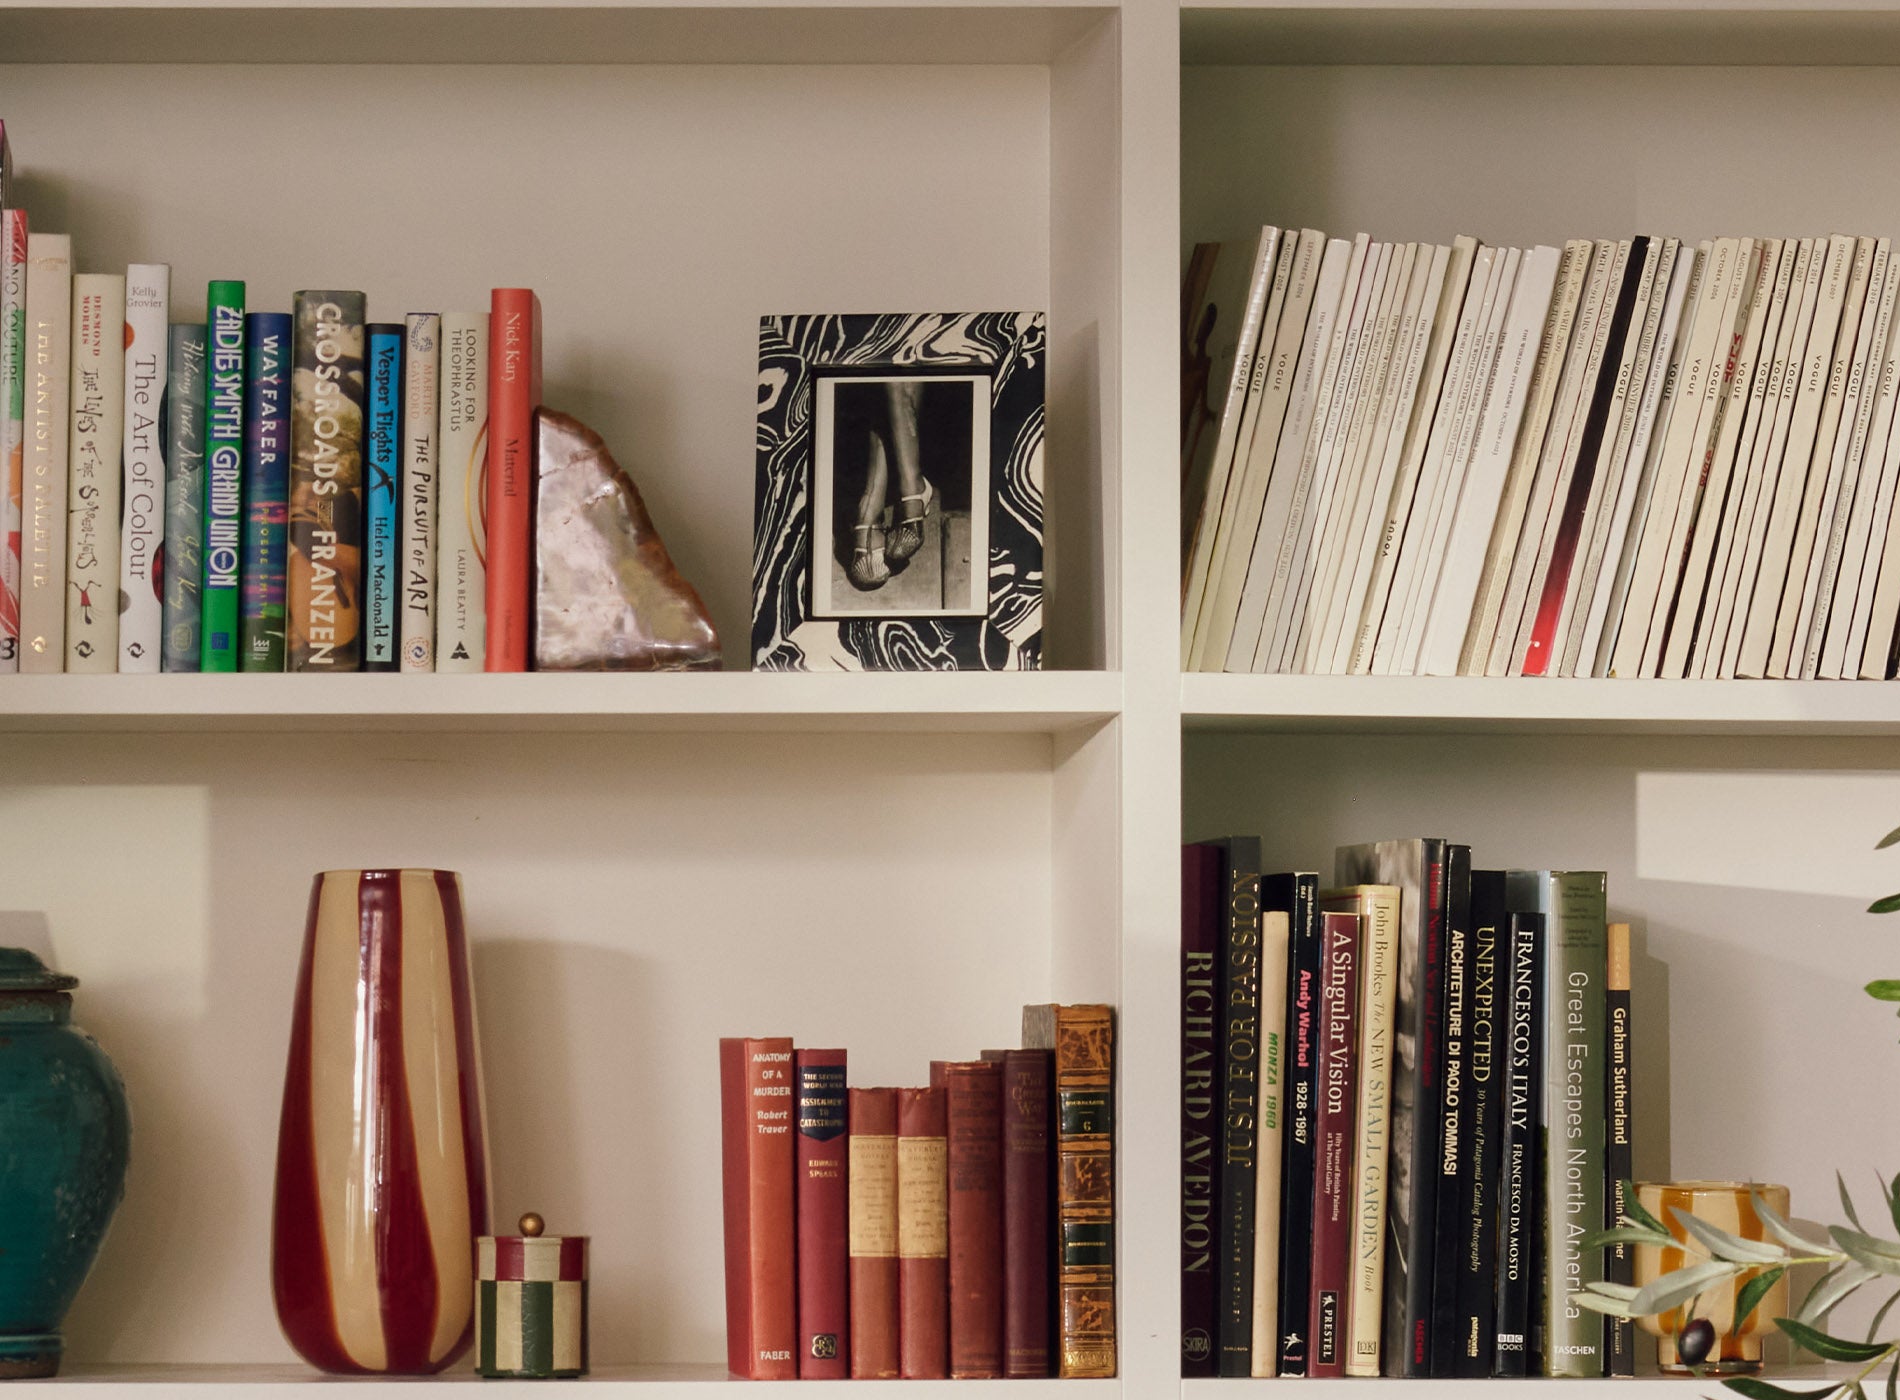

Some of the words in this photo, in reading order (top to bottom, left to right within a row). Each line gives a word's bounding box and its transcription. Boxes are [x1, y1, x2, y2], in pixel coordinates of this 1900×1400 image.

[1716, 248, 1727, 283] OCTOBER
[1834, 244, 1845, 283] DECEMBER
[1874, 250, 1886, 287] FEBRUARY
[127, 298, 162, 309] Grovier
[133, 286, 156, 298] Kelly
[2, 301, 20, 385] COUTURE
[81, 296, 90, 345] MORRIS
[92, 296, 101, 356] DESMOND
[215, 305, 241, 372] ZADIE
[504, 312, 520, 348] Nick
[37, 319, 55, 368] THE
[464, 329, 476, 394] LOOKING
[133, 355, 156, 404] The
[178, 340, 204, 396] Hiking
[376, 347, 395, 406] Vesper
[410, 360, 421, 419] GAYFORD
[423, 364, 433, 415] MARTIN
[450, 328, 462, 432] THEOPHRASTUS
[501, 351, 519, 383] Kary
[1236, 353, 1250, 392] VOGUE
[1252, 355, 1266, 393] VOGUE
[1274, 353, 1288, 391] VOGUE
[1616, 363, 1630, 400] VOGUE
[1664, 363, 1678, 400] VOGUE
[1687, 359, 1702, 396] VOGUE
[1707, 363, 1721, 400] VOGUE
[1755, 362, 1768, 399] VOGUE
[1808, 355, 1822, 392] VOGUE
[1849, 362, 1862, 399] VOGUE
[76, 396, 102, 433] LIVES
[213, 373, 241, 438] SMITH
[260, 335, 278, 465] WAYFARER
[312, 302, 341, 496] CROSSROADS
[466, 398, 476, 423] FOR
[133, 413, 154, 457] Art
[371, 410, 394, 462] Flights
[415, 435, 430, 463] THE
[132, 462, 156, 485] of
[211, 446, 238, 514] GRAND
[503, 438, 518, 497] Material
[412, 472, 431, 544] PURSUIT
[130, 493, 153, 580] Colour
[209, 520, 238, 587] UNION
[260, 507, 270, 564] PHOEBE
[374, 517, 387, 559] Helen
[413, 550, 425, 566] OF
[457, 549, 467, 585] LAURA
[309, 530, 335, 664] FRANZEN
[373, 564, 387, 637] Macdonald
[408, 571, 429, 616] ART
[456, 590, 466, 630] BEATTY
[1232, 869, 1259, 1007] PASSION
[1333, 932, 1351, 949] A
[1372, 904, 1391, 938] John
[1296, 970, 1312, 1009] Andy
[1371, 940, 1388, 996] Brookes
[1446, 930, 1465, 1036] ARCHITETTURE
[1326, 952, 1350, 1041] Singular
[1373, 1002, 1386, 1025] The
[1472, 926, 1495, 1082] UNEXPECTED
[1512, 930, 1534, 1069] FRANCESCO'S
[1565, 972, 1589, 1038] Great
[753, 1053, 791, 1062] ANATOMY
[1182, 950, 1214, 1125] RICHARD
[1229, 1018, 1255, 1094] FOR
[1296, 1013, 1311, 1067] Warhol
[1370, 1028, 1386, 1073] NEW
[1447, 1042, 1460, 1055] DI
[1610, 1008, 1628, 1064] Graham
[762, 1071, 773, 1079] OF
[777, 1071, 782, 1079] A
[1267, 1032, 1279, 1086] MONZA
[1328, 1046, 1348, 1114] Vision
[754, 1087, 791, 1096] MURDER
[1444, 1060, 1460, 1107] PAOLO
[1477, 1089, 1486, 1099] 30
[1510, 1074, 1530, 1131] ITALY
[1561, 1044, 1588, 1139] Escapes
[757, 1111, 787, 1119] Robert
[757, 1125, 787, 1133] Traver
[1265, 1094, 1278, 1129] 1960
[1294, 1081, 1308, 1145] 1928-1987
[1365, 1079, 1384, 1159] SMALL
[1476, 1102, 1485, 1124] Years
[1613, 1068, 1629, 1145] Sutherland
[1226, 1100, 1255, 1169] JUST
[1444, 1110, 1459, 1175] TOMMASI
[1474, 1138, 1484, 1180] Patagonia
[1510, 1143, 1522, 1213] FRANCESCO
[1565, 1149, 1587, 1214] North
[1182, 1128, 1212, 1273] AVEDON
[1332, 1195, 1340, 1221] Painting
[1361, 1166, 1382, 1261] GARDEN
[1472, 1182, 1483, 1215] Catalog
[1471, 1218, 1482, 1272] Photography
[1509, 1217, 1519, 1234] DA
[1364, 1265, 1375, 1293] Book
[1507, 1238, 1519, 1281] MOSTO
[760, 1350, 790, 1360] FABER
[1184, 1337, 1209, 1350] SKIRA
[1323, 1309, 1332, 1357] PRESTEL
[1360, 1342, 1375, 1350] DK
[1415, 1319, 1425, 1364] TASCHEN
[1498, 1334, 1523, 1342] BBC
[1554, 1346, 1595, 1354] TASCHEN
